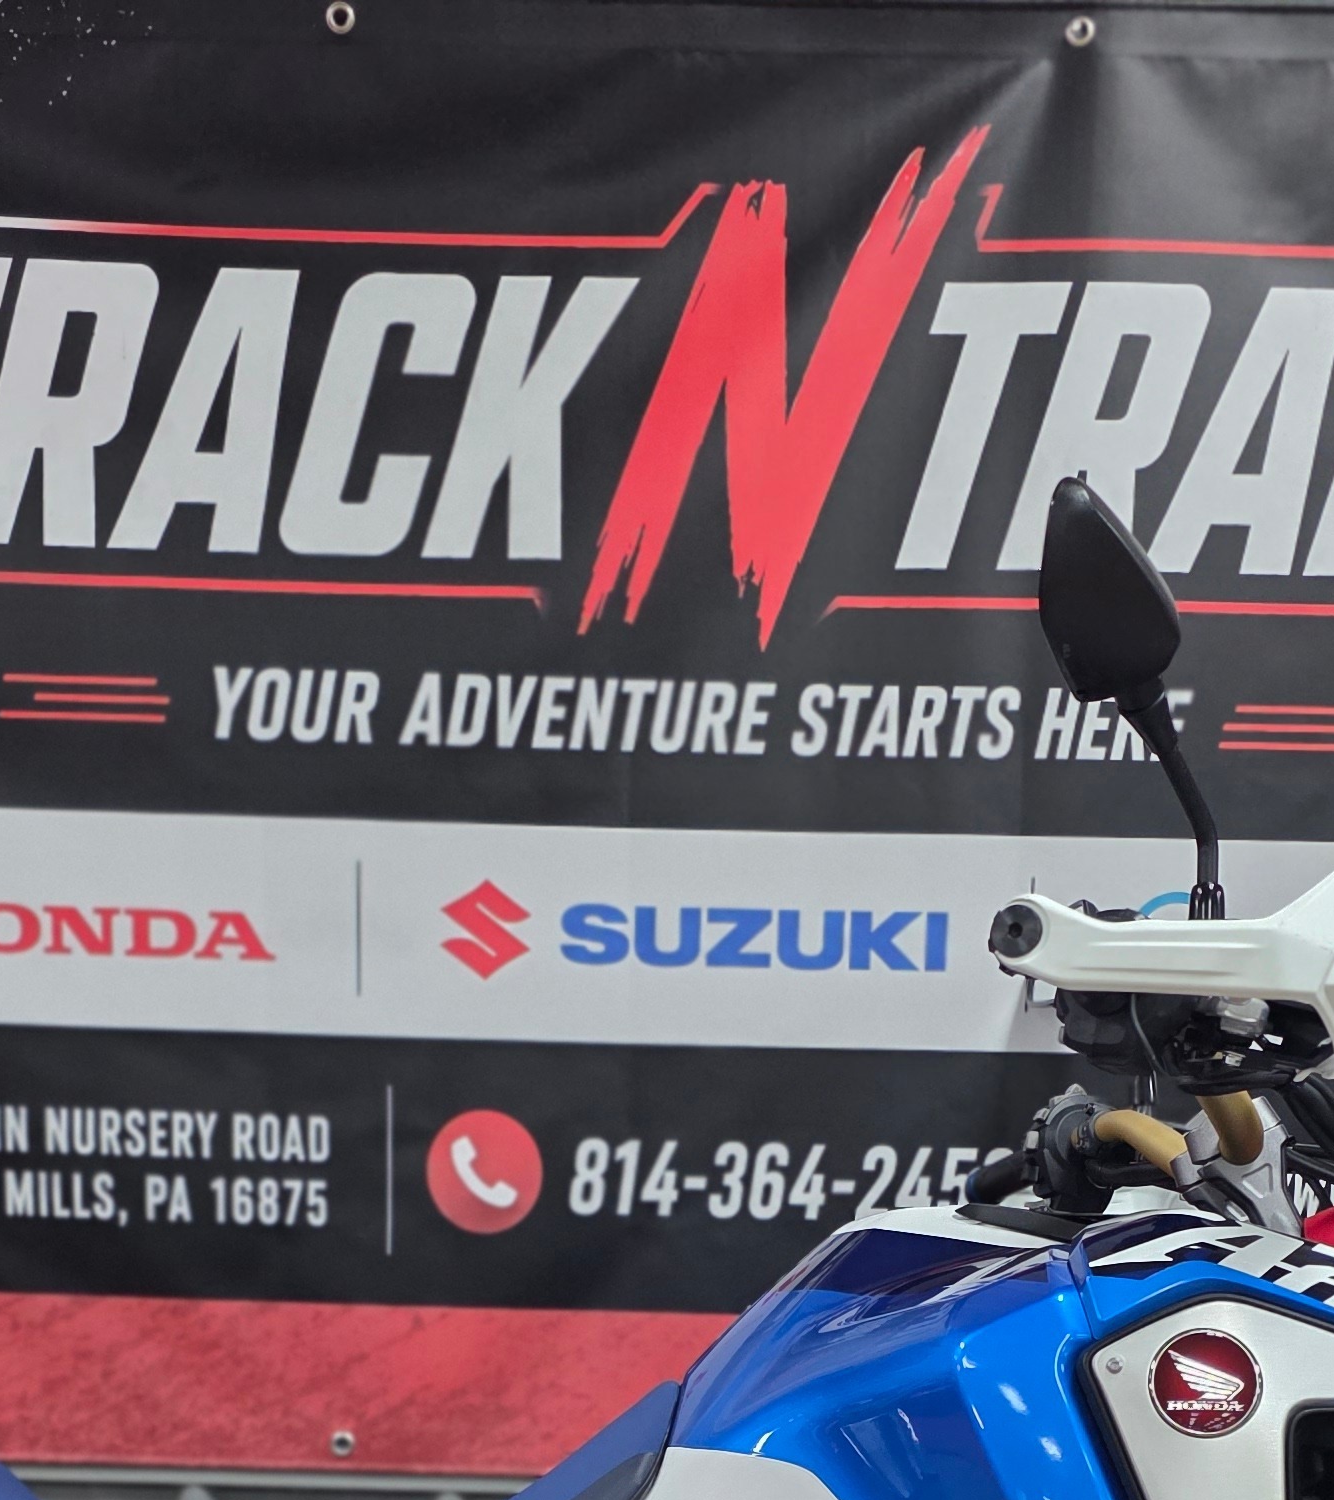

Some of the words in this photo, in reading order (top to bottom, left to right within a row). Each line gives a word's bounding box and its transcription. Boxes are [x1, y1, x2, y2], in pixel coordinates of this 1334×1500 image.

[577, 124, 992, 653] N
[213, 666, 380, 744] YOUR
[398, 671, 777, 756] ADVENTURE
[790, 683, 1022, 761] STARTS
[560, 903, 949, 973] SUZUKI
[44, 1107, 218, 1160] NURSERY
[232, 1115, 332, 1163] ROAD
[4, 1168, 130, 1227] MILLS,
[145, 1176, 193, 1223] PA
[210, 1178, 330, 1227] 16875
[569, 1136, 1014, 1222] 814-364-245
[1167, 1400, 1244, 1411] HONDA
